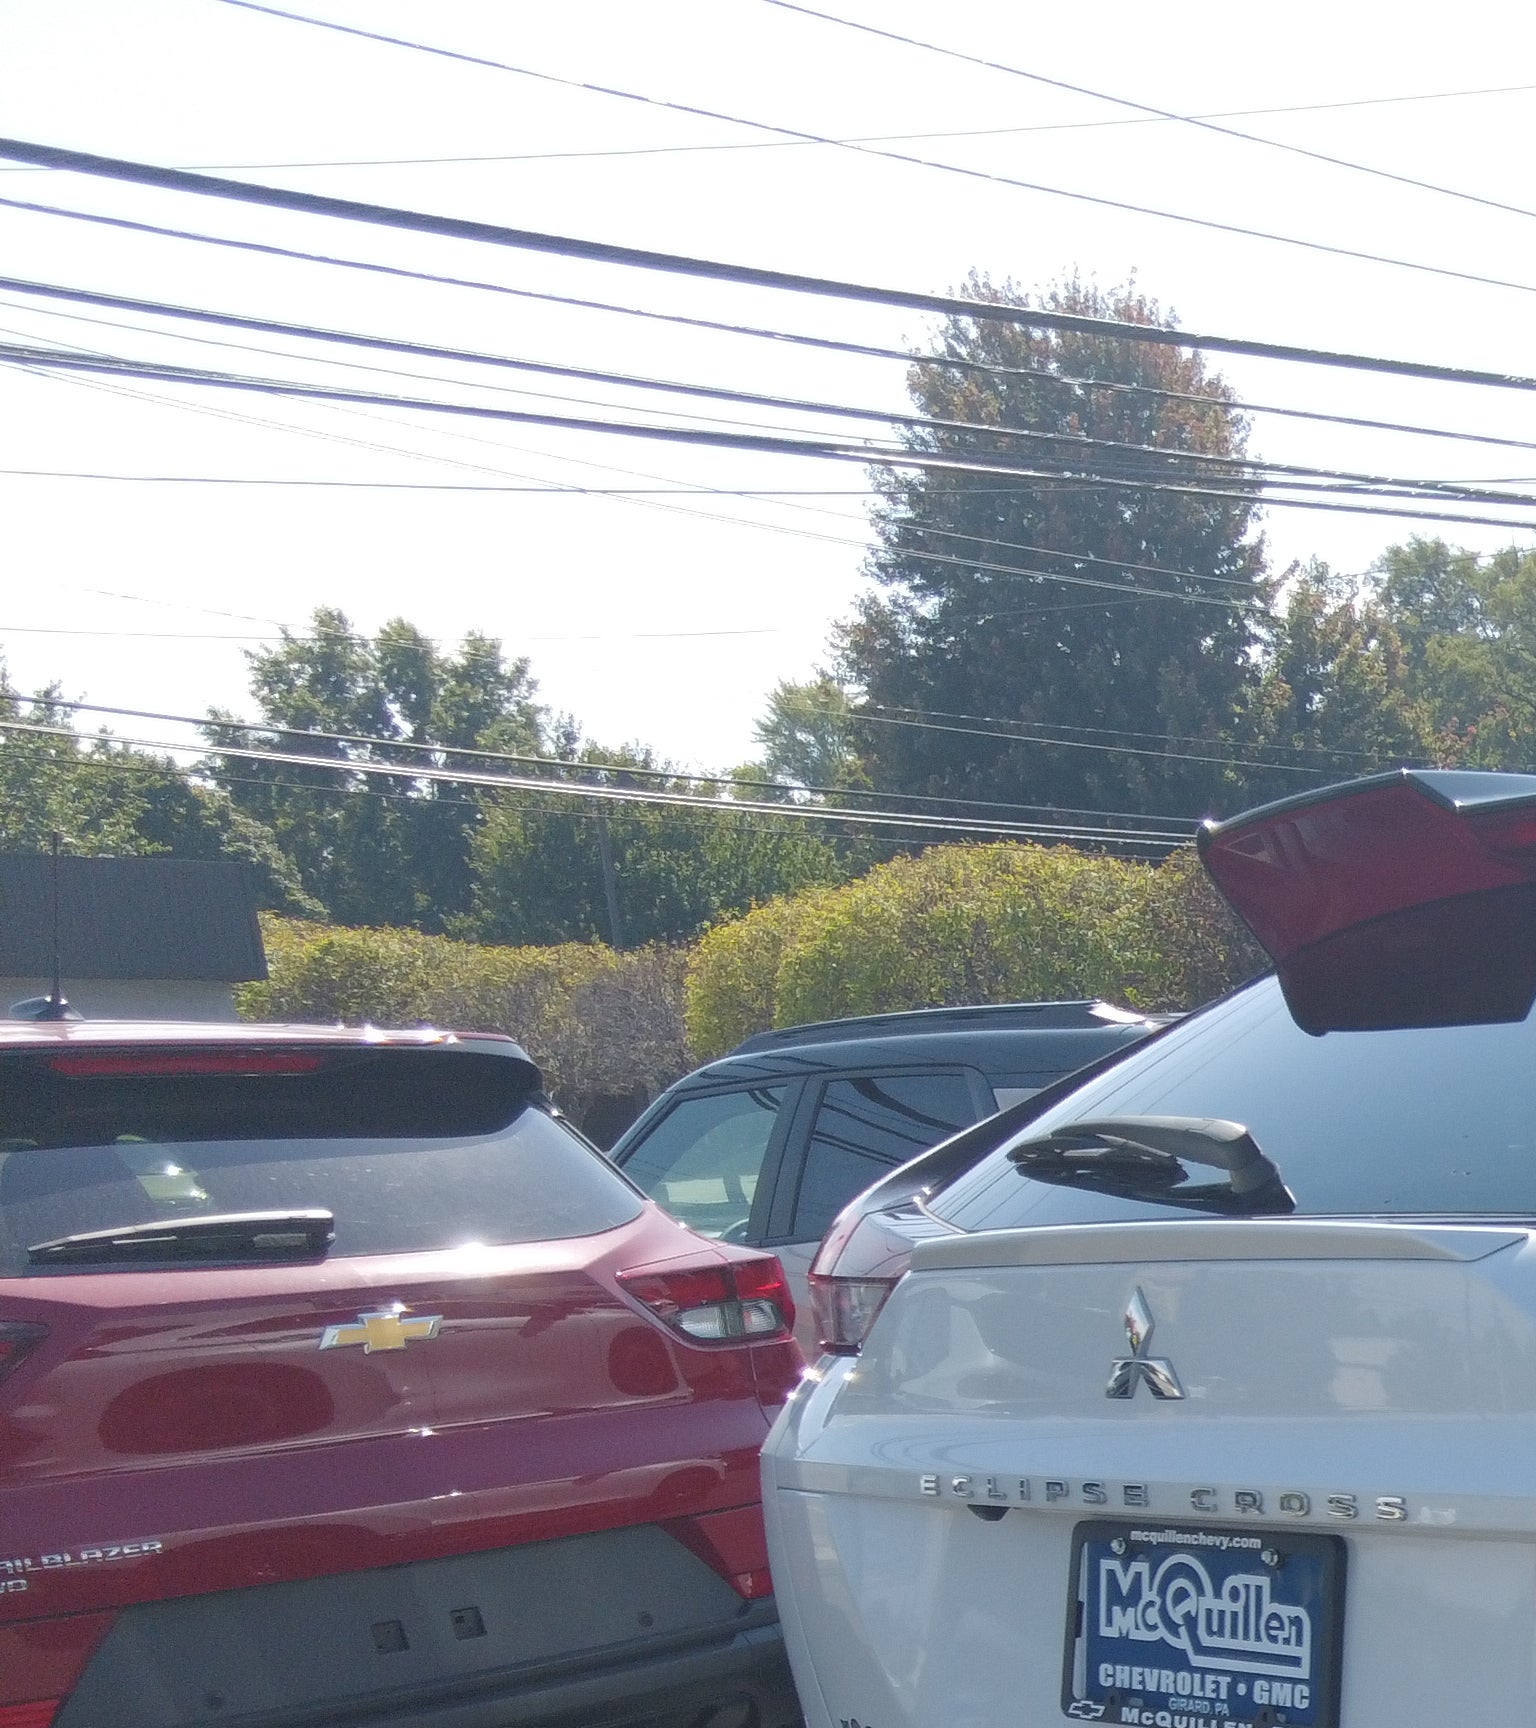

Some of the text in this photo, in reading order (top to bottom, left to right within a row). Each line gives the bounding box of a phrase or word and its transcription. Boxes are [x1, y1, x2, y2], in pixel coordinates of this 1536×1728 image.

[920, 1474, 1407, 1521] ECLIPSE CROSS
[1130, 1529, 1262, 1550] mcquillenchevy.com
[1099, 1663, 1311, 1710] CHEVROLET GMC
[1214, 1703, 1230, 1717] PA
